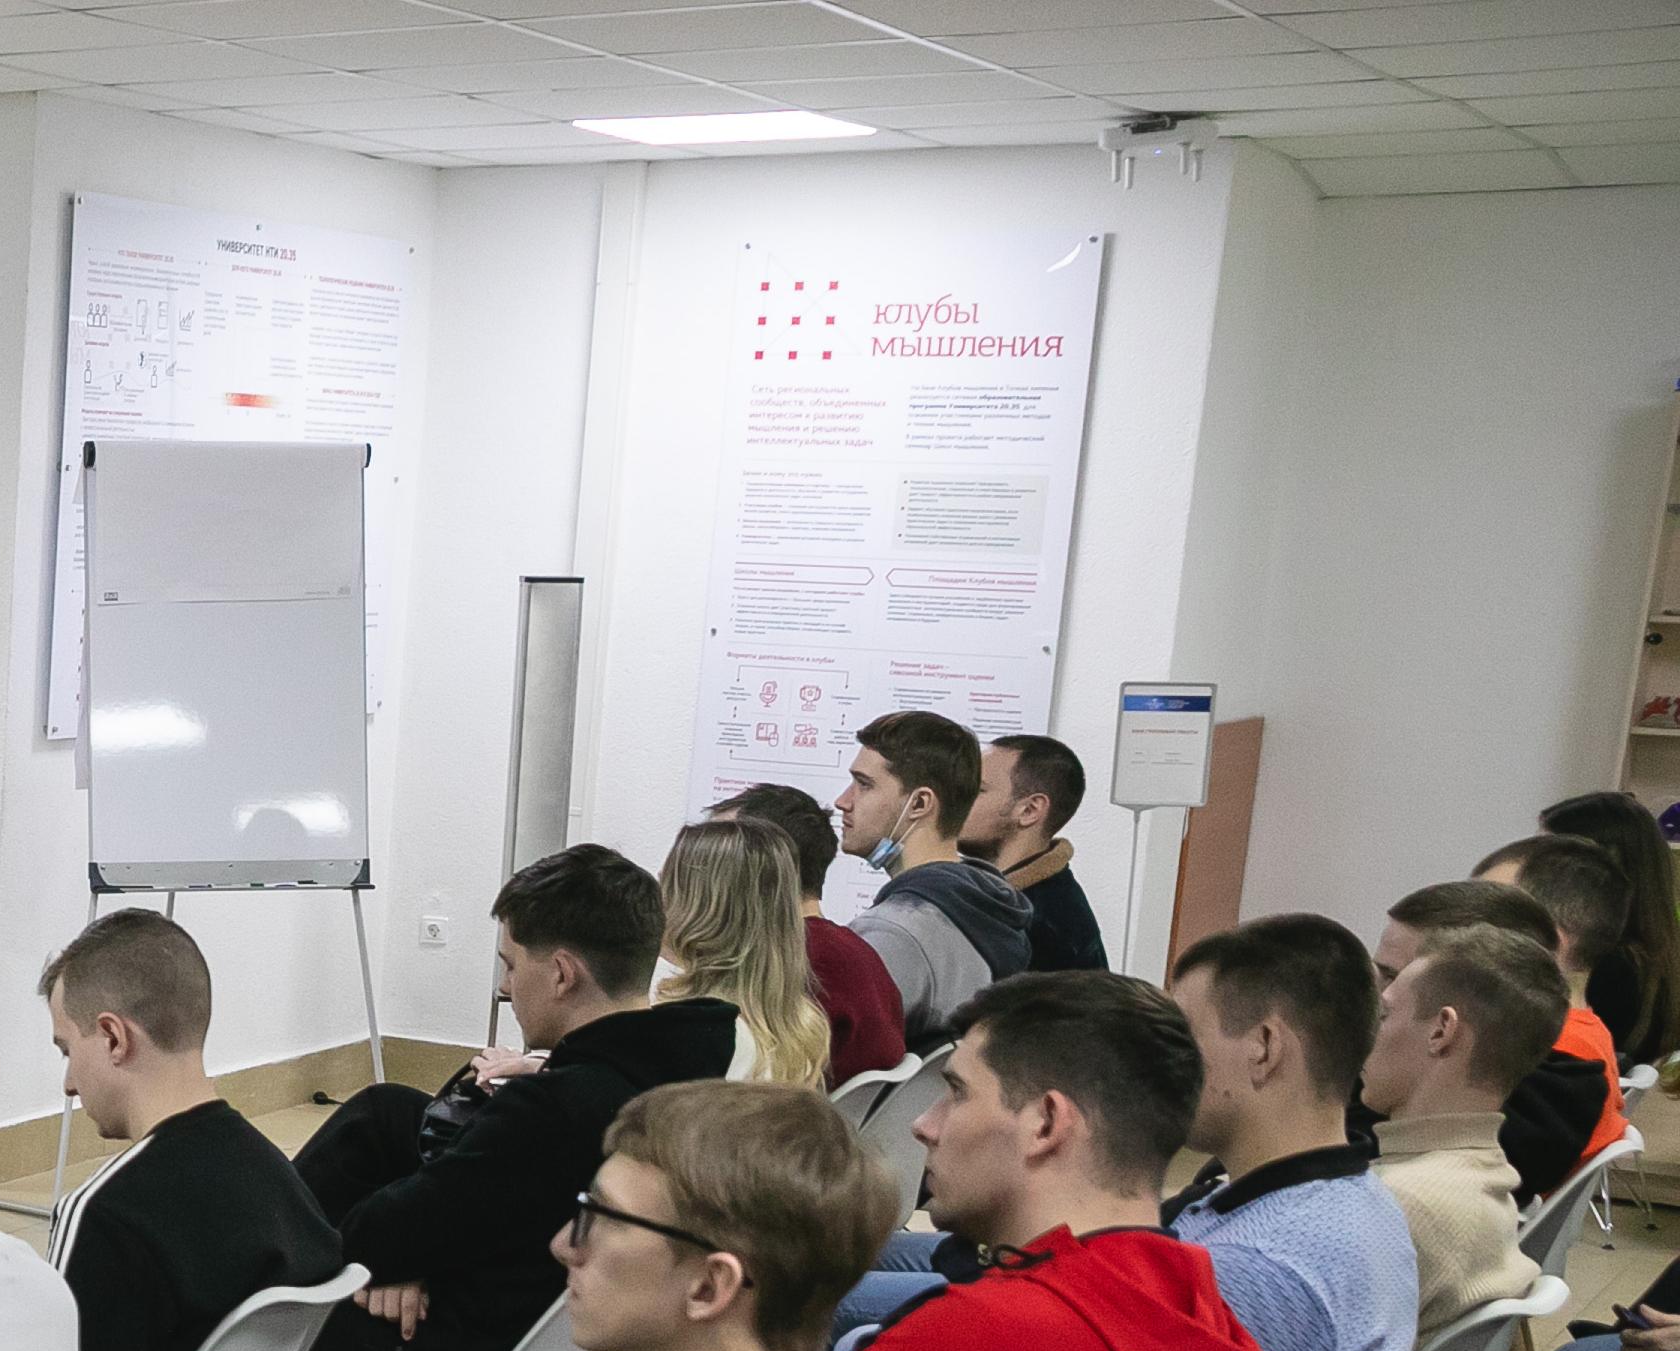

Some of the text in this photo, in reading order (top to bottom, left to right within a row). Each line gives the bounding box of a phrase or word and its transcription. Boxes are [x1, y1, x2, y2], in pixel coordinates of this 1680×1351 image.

[216, 239, 264, 256] УНИВЕРСИТЕТ
[873, 293, 980, 332] клубы
[871, 335, 1064, 357] мышления
